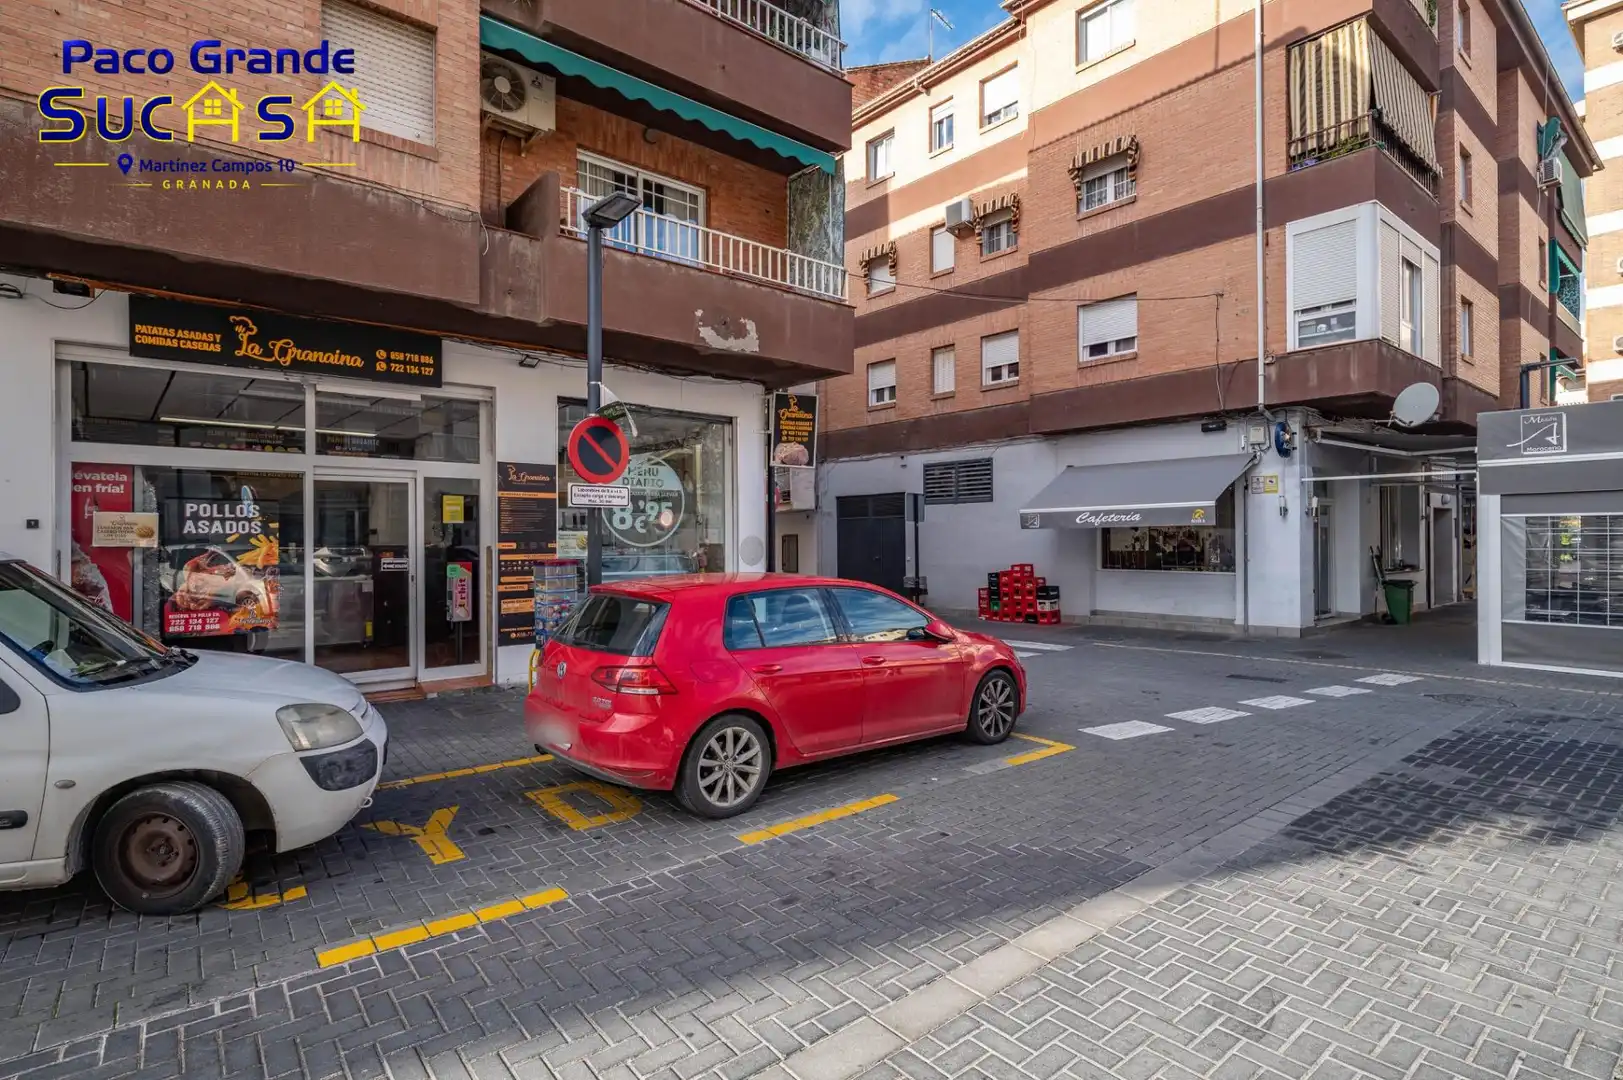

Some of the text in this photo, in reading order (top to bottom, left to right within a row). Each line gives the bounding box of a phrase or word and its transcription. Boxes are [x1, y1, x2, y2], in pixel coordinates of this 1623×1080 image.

[135, 324, 222, 343] PATATAS ASADAS Y
[135, 334, 221, 353] COMIDAS CASERAS
[235, 333, 365, 367] La Granaina
[405, 353, 419, 362] 718
[390, 363, 405, 373] 722
[420, 366, 434, 376] 127
[72, 470, 128, 482] évatela
[72, 483, 125, 494] en fría!
[185, 503, 261, 518] POLLOS
[1076, 511, 1142, 527] Cafetería
[183, 520, 262, 534] ASADOS
